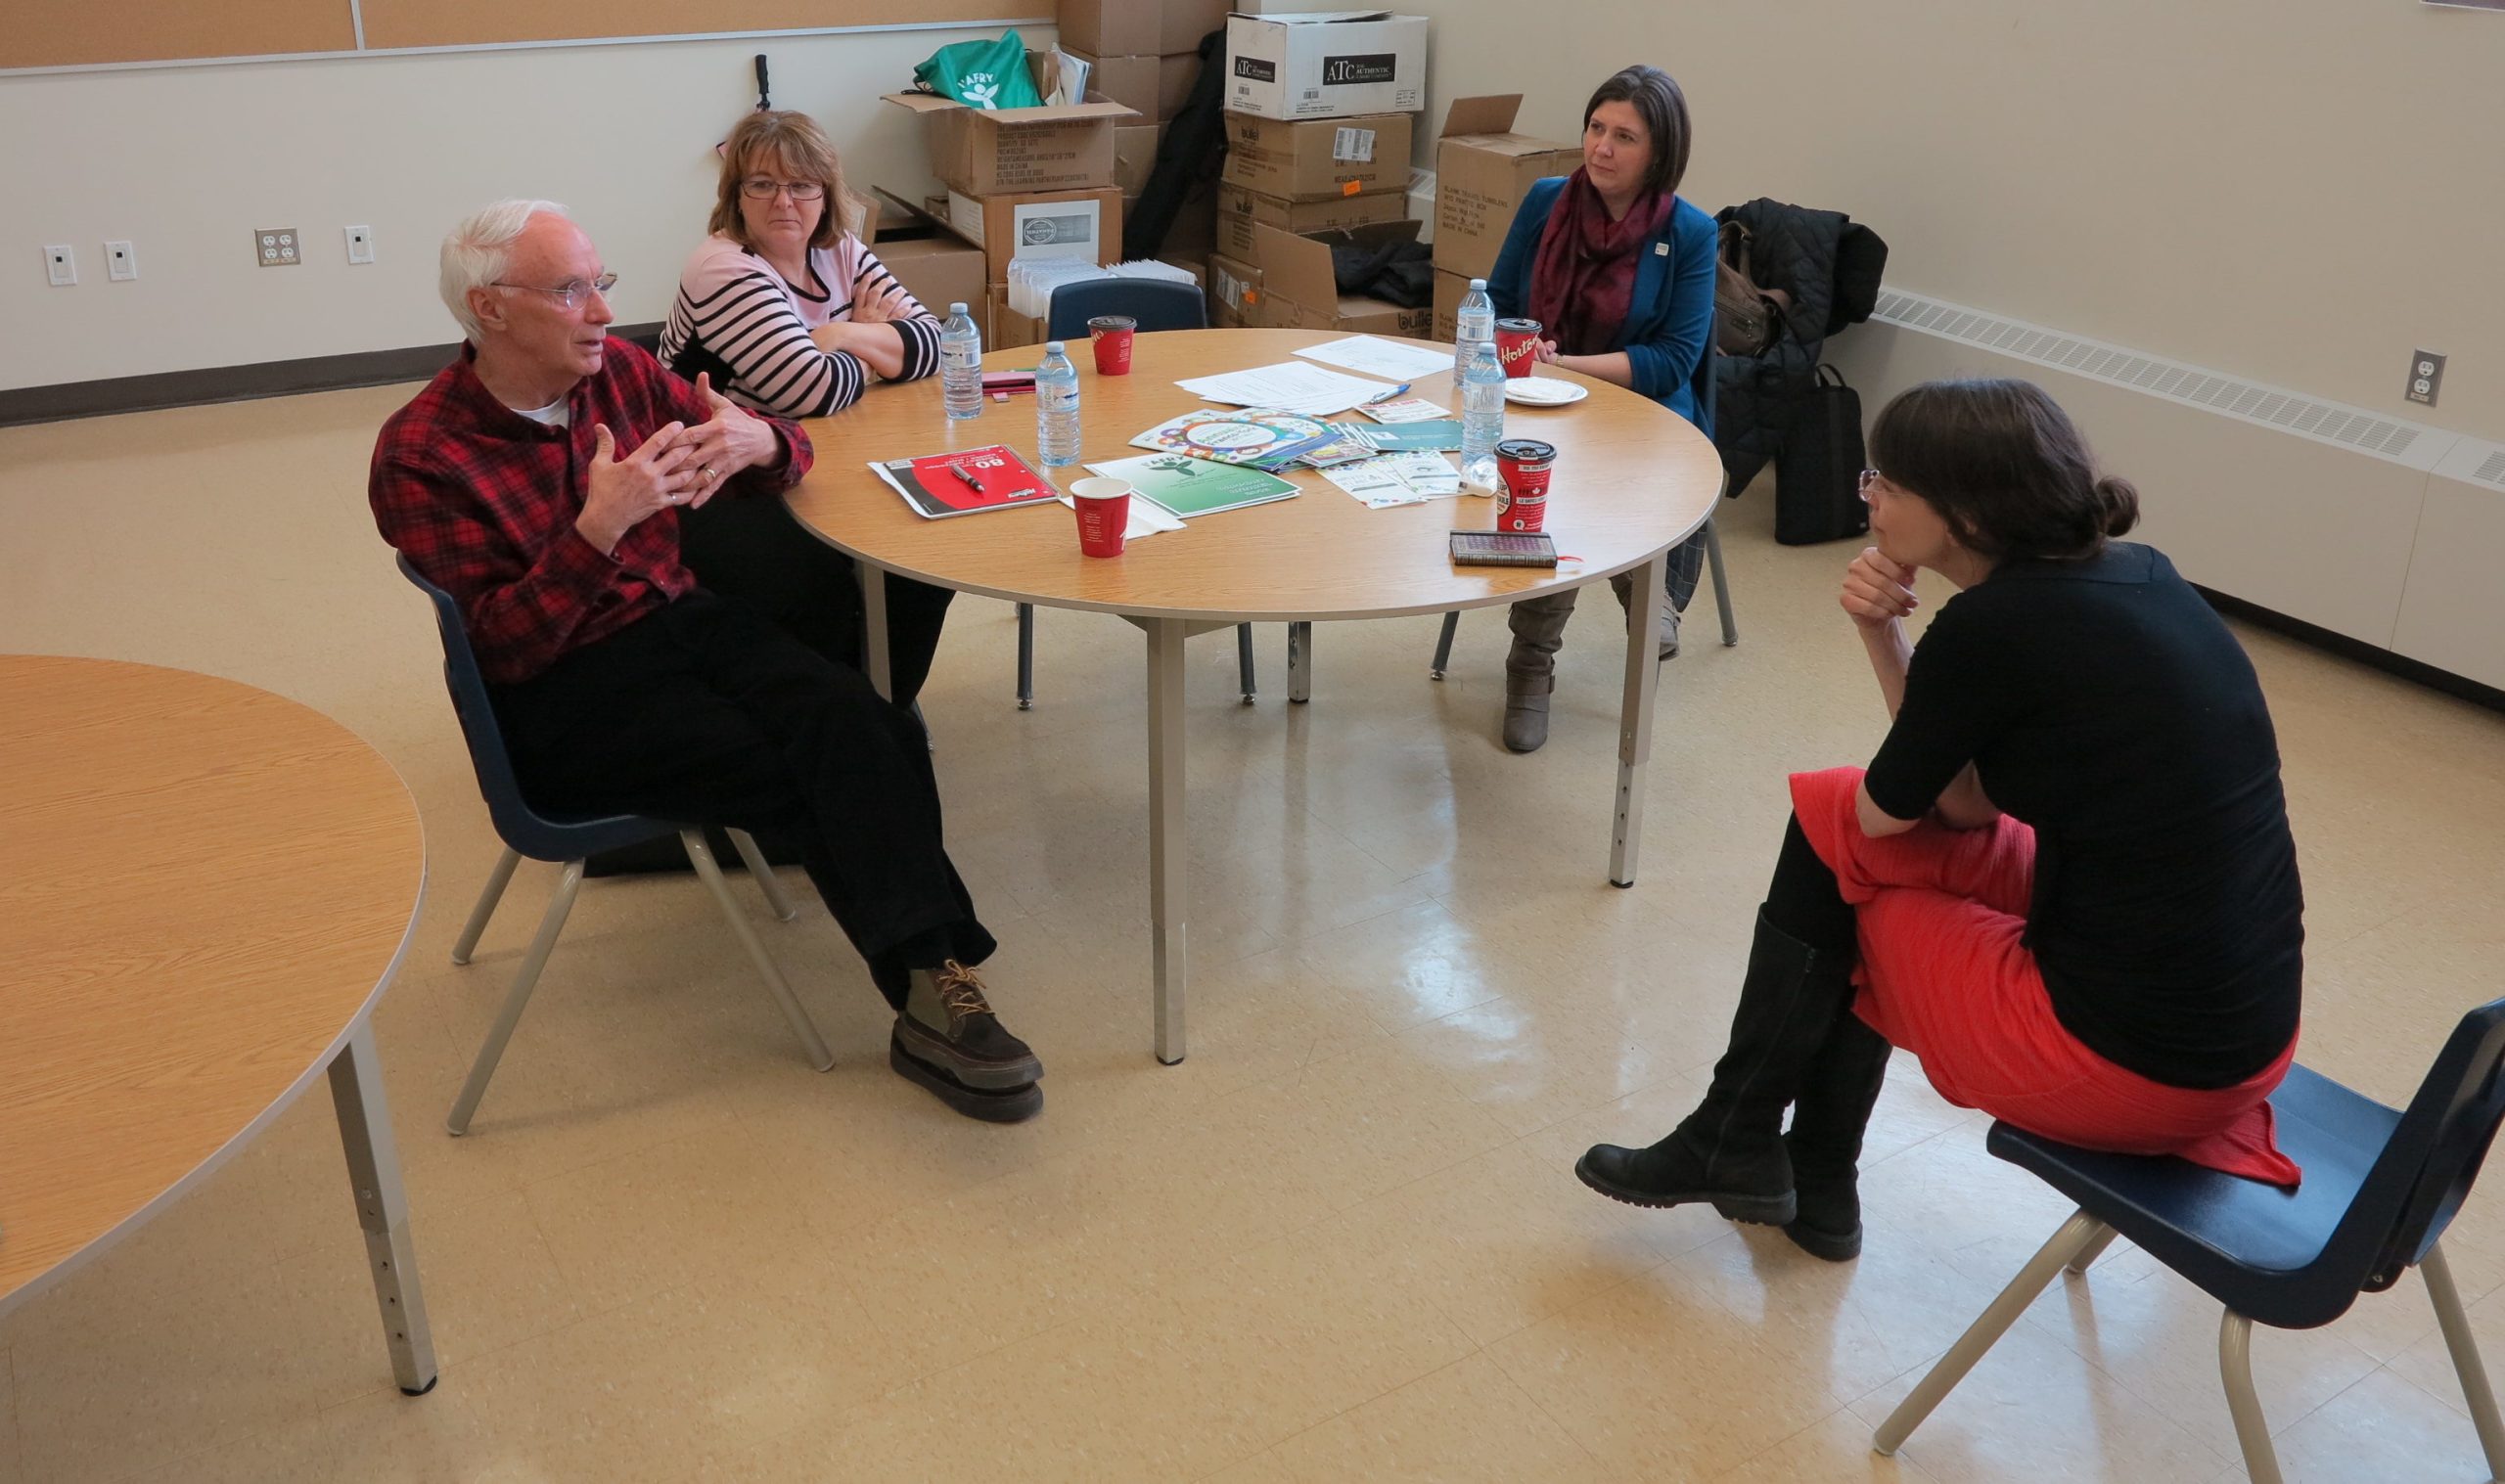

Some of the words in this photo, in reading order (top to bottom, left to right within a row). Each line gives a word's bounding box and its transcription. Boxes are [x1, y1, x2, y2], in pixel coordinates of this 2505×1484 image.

[1236, 60, 1252, 76] ATC
[1327, 60, 1355, 81] ATC
[1397, 310, 1434, 331] bulle
